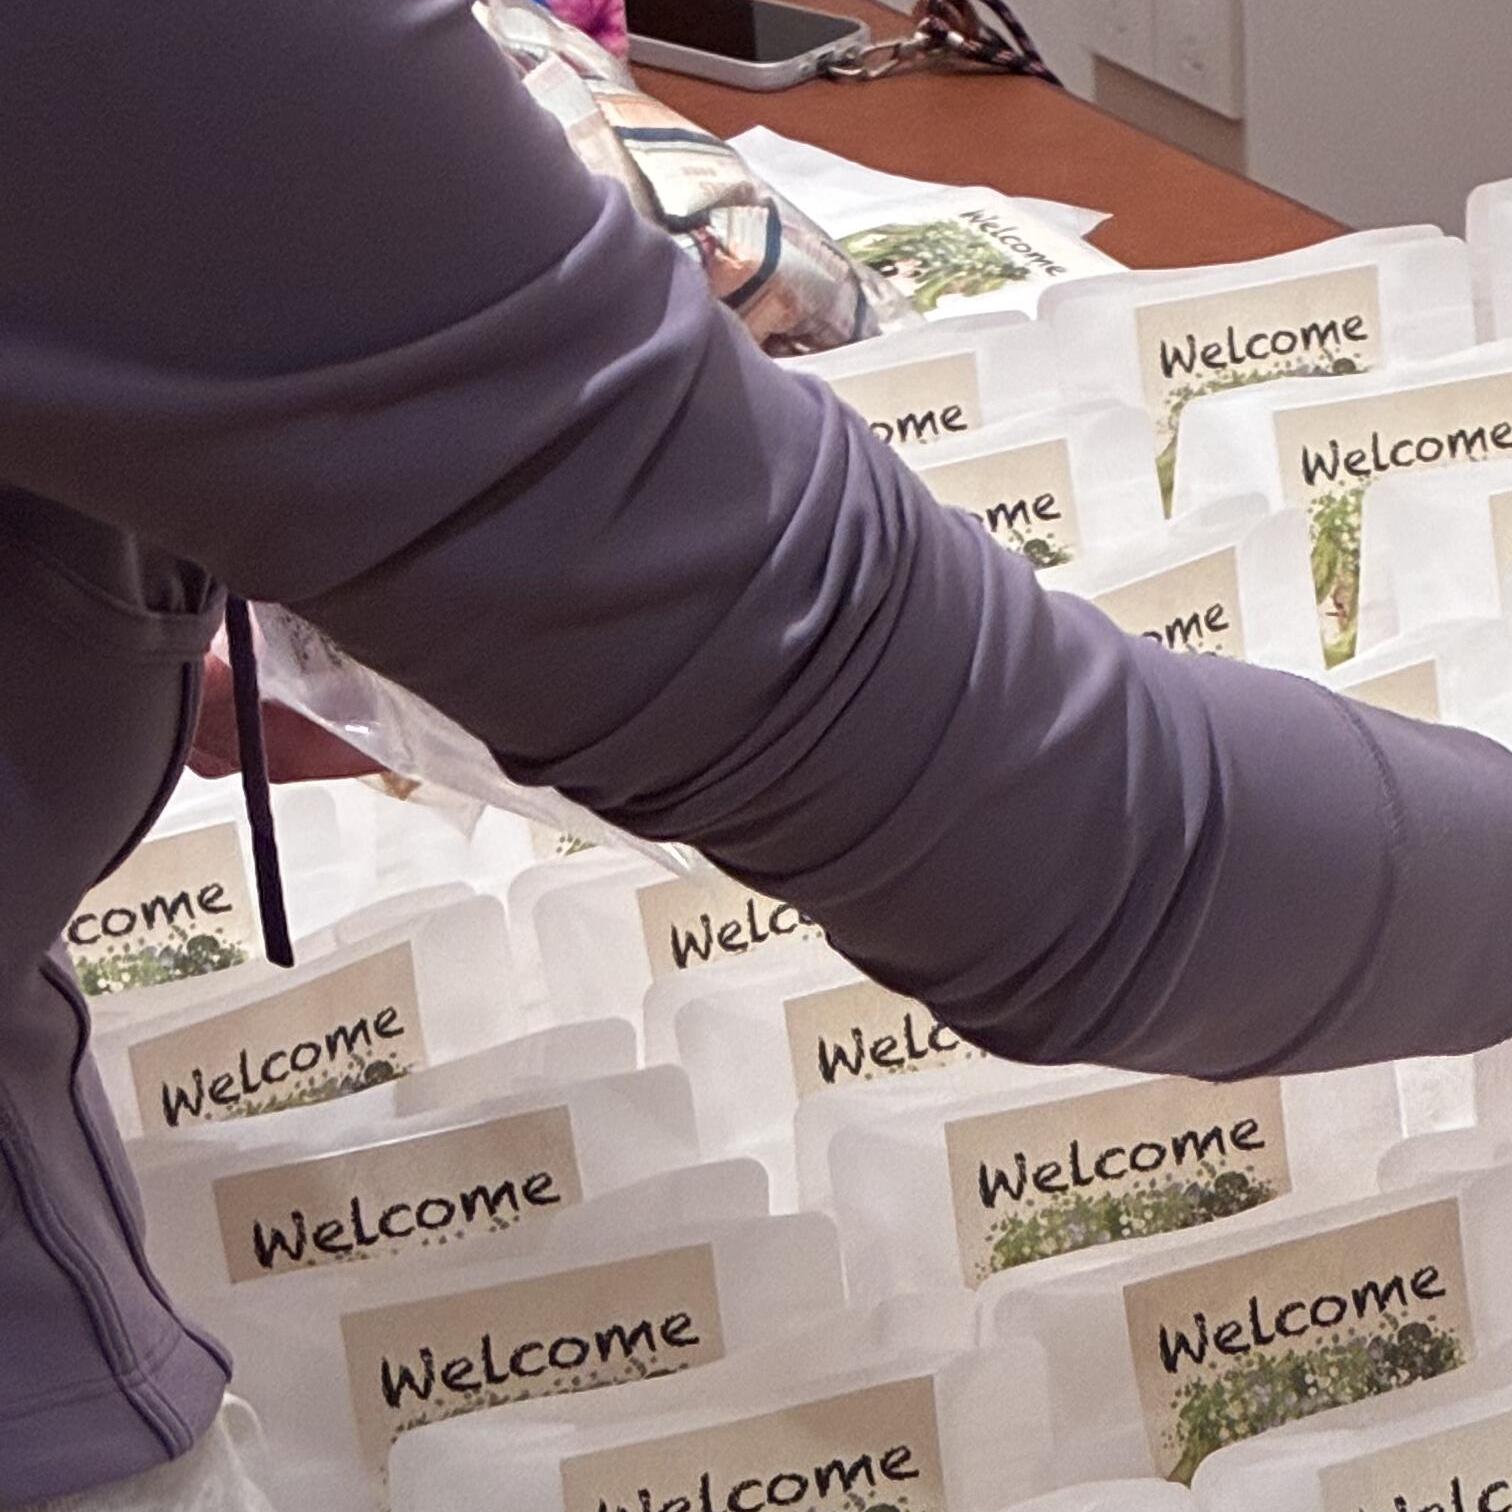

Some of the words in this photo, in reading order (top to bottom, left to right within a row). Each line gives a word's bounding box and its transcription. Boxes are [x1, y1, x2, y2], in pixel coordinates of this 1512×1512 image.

[960, 208, 1067, 277] Welcome
[1160, 314, 1369, 379] Welcome
[66, 882, 233, 945] come
[161, 1003, 405, 1128] Welcome
[978, 1115, 1266, 1209] Welcome
[252, 1167, 561, 1269] Welcome
[381, 1308, 700, 1409] Welcome
[1159, 1262, 1447, 1375] Welcome
